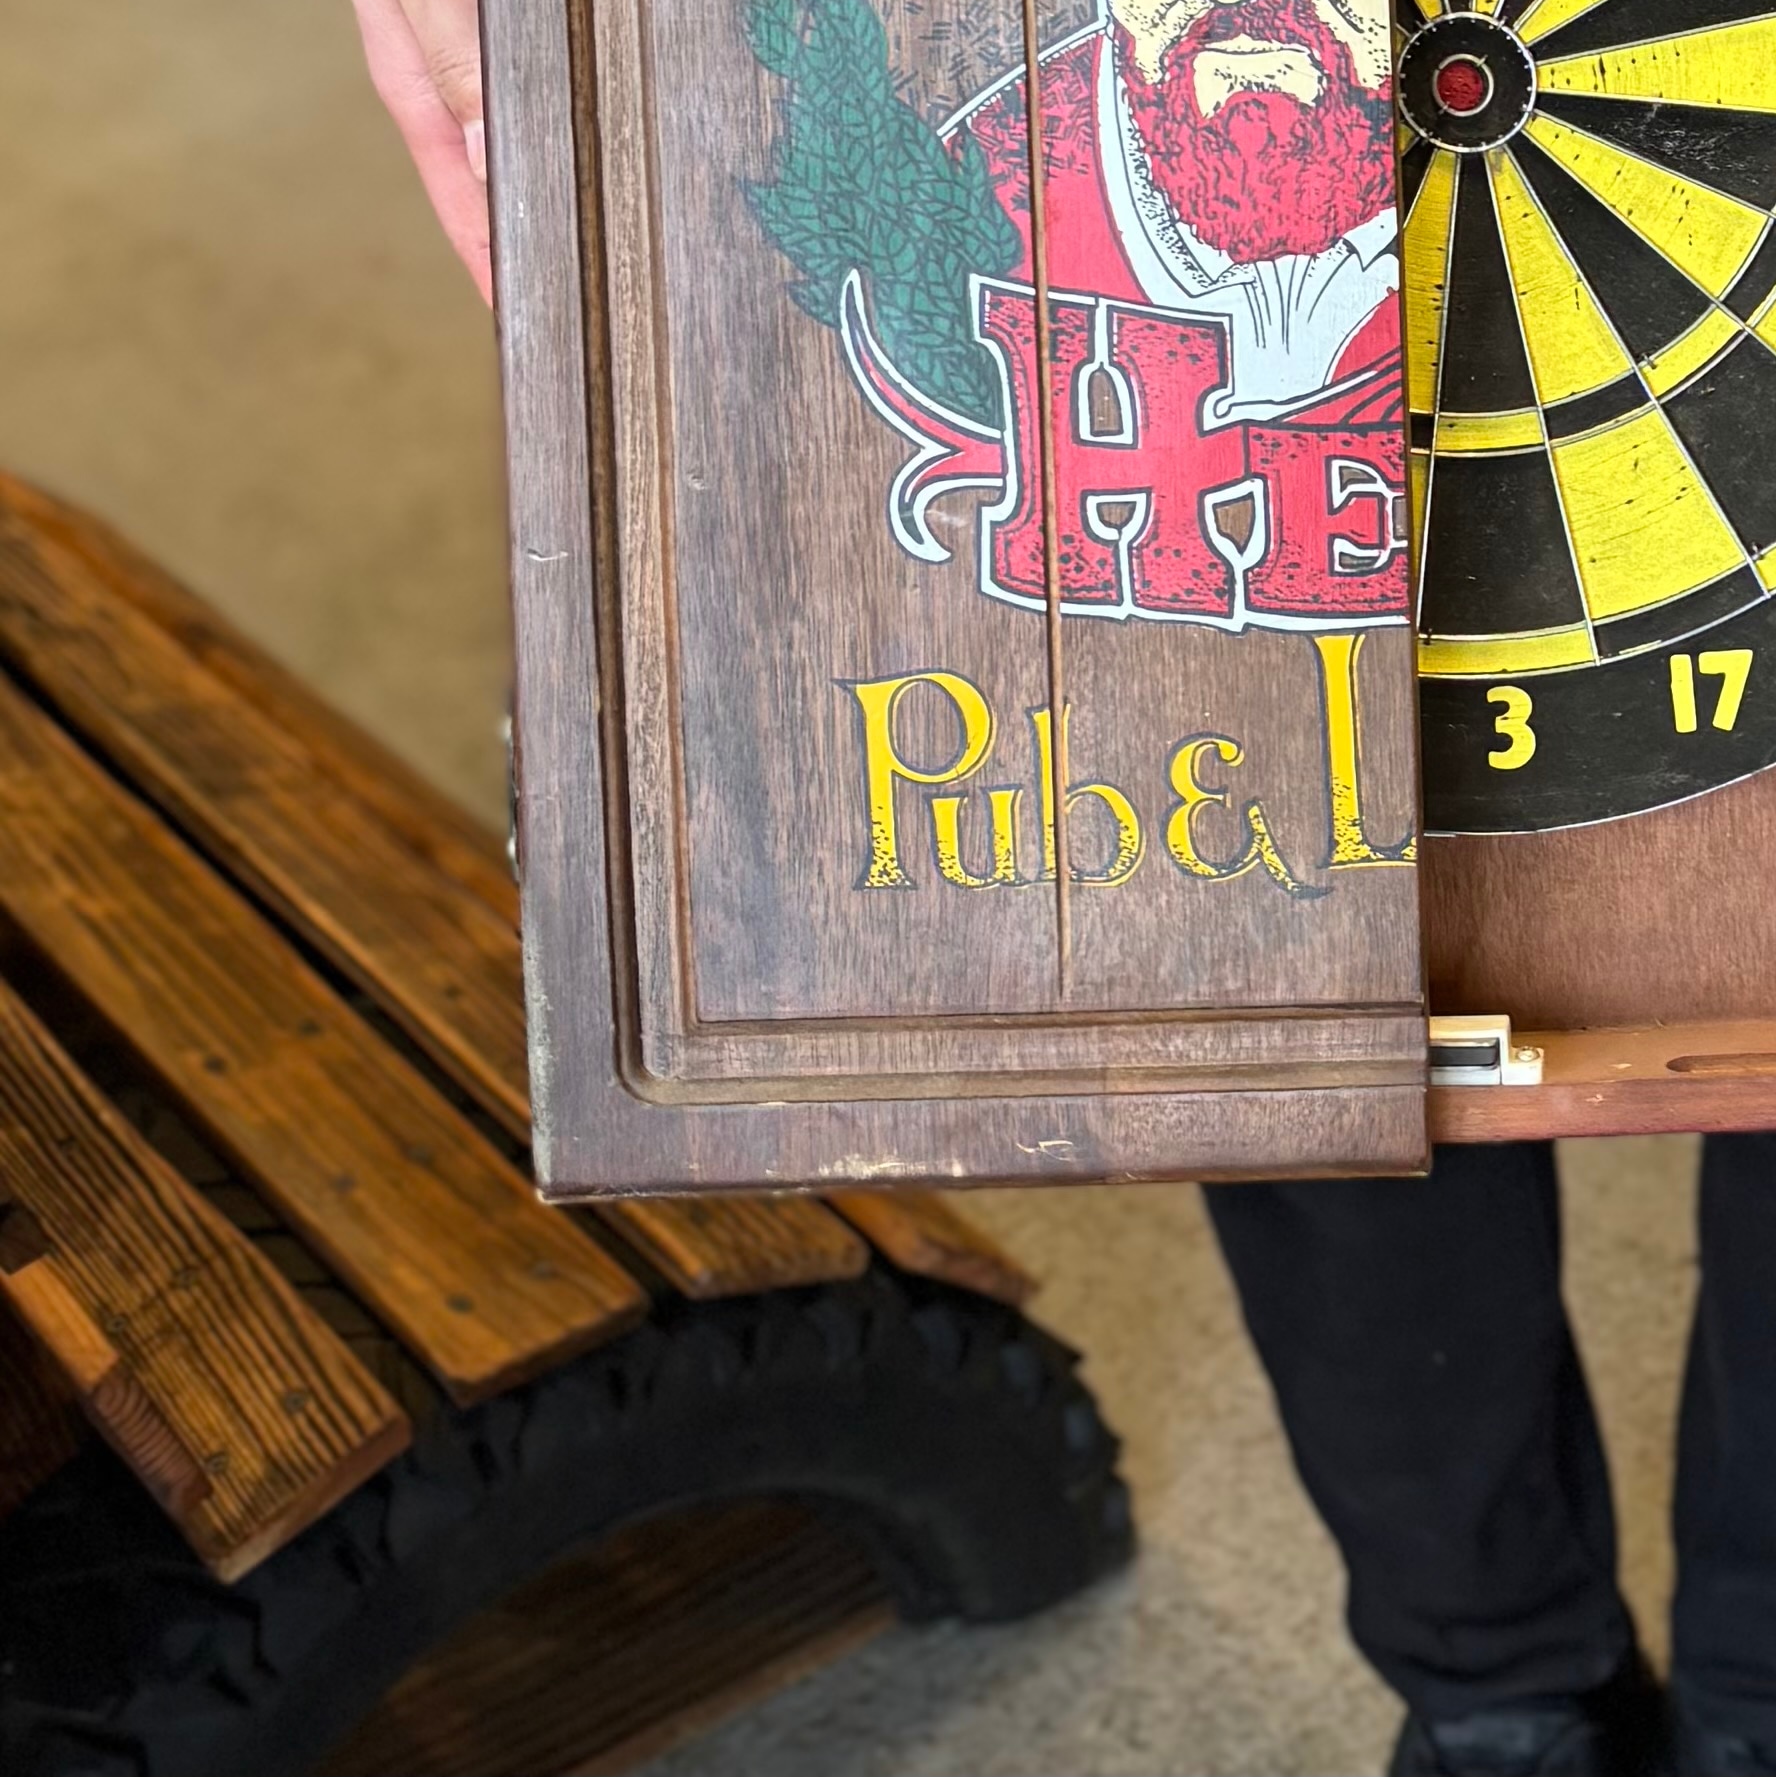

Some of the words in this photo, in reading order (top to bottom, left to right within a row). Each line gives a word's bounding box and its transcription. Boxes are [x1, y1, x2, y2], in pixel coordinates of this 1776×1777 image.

[1486, 686, 1536, 769] 3
[1669, 649, 1753, 733] 17
[838, 670, 1145, 890] Pub
[1164, 734, 1332, 897] &
